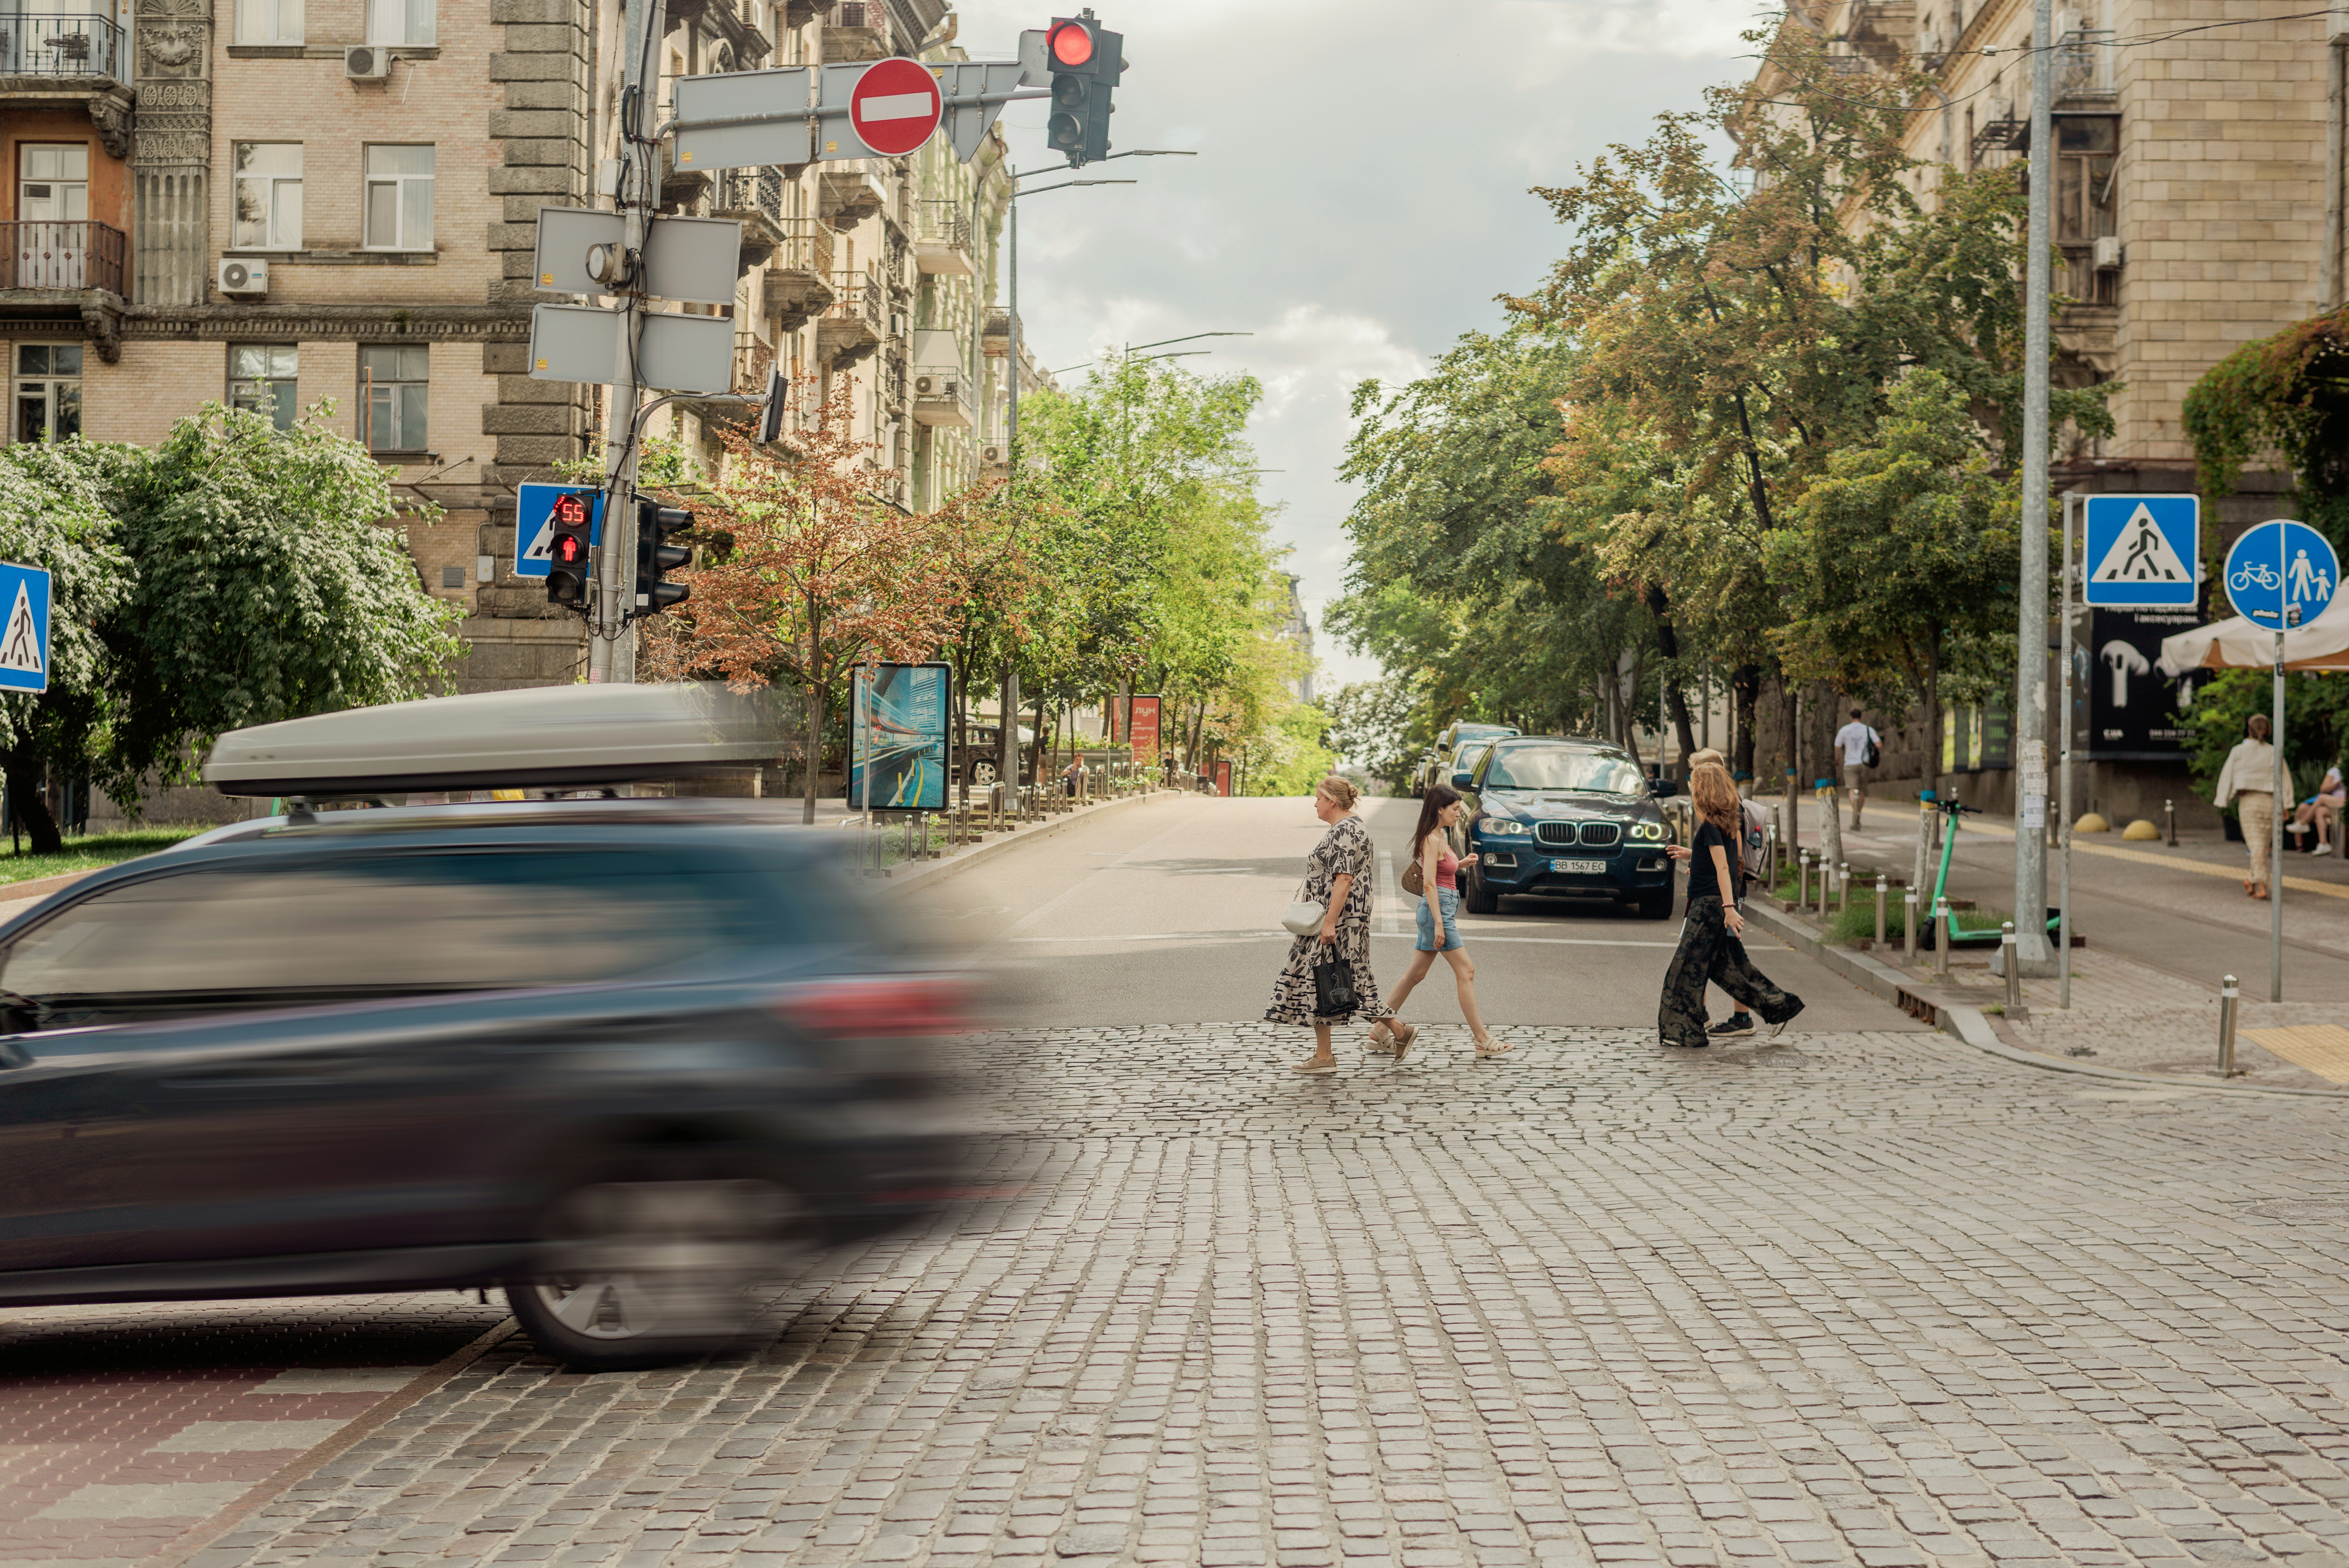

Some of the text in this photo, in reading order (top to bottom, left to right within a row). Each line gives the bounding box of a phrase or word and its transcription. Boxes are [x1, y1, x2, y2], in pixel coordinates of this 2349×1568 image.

[563, 504, 584, 521] 55
[1571, 862, 1590, 870] 1567
[1592, 862, 1604, 870] EC
